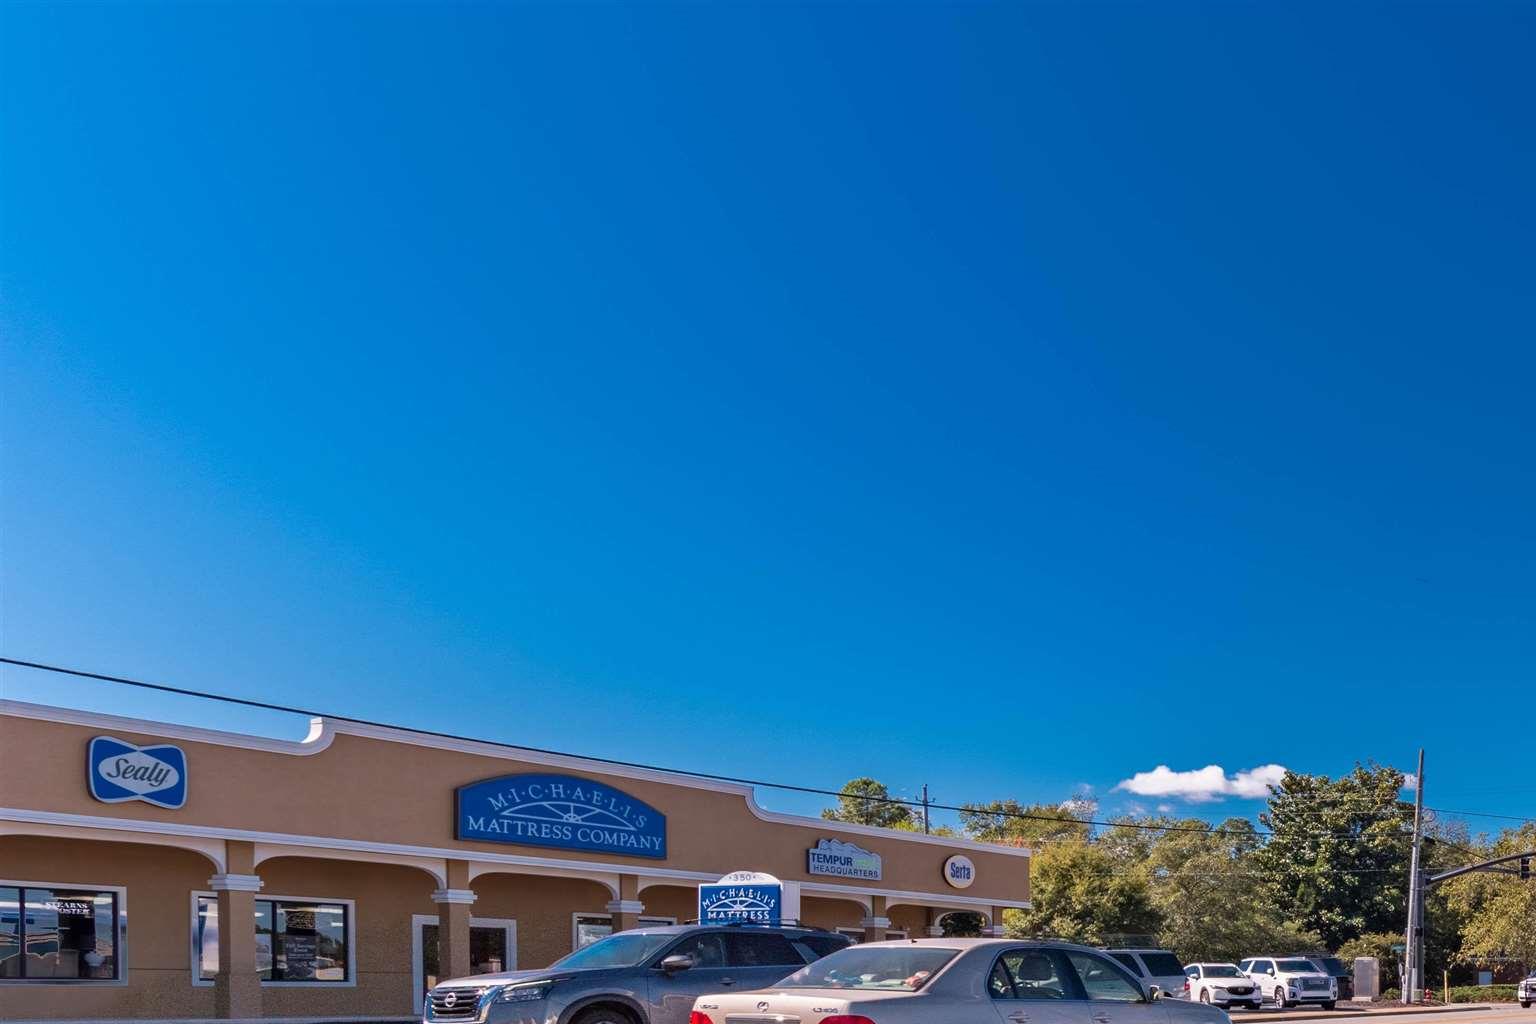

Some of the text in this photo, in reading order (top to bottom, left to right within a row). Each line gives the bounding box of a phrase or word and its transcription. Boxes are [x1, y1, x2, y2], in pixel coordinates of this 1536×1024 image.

[106, 758, 170, 787] Sealy
[467, 815, 664, 850] MATTRESS COMPANY
[810, 852, 853, 867] TEMPUR
[813, 865, 879, 878] HEADQUARTERS
[950, 862, 971, 880] Serta
[707, 911, 770, 920] MATTRESS
